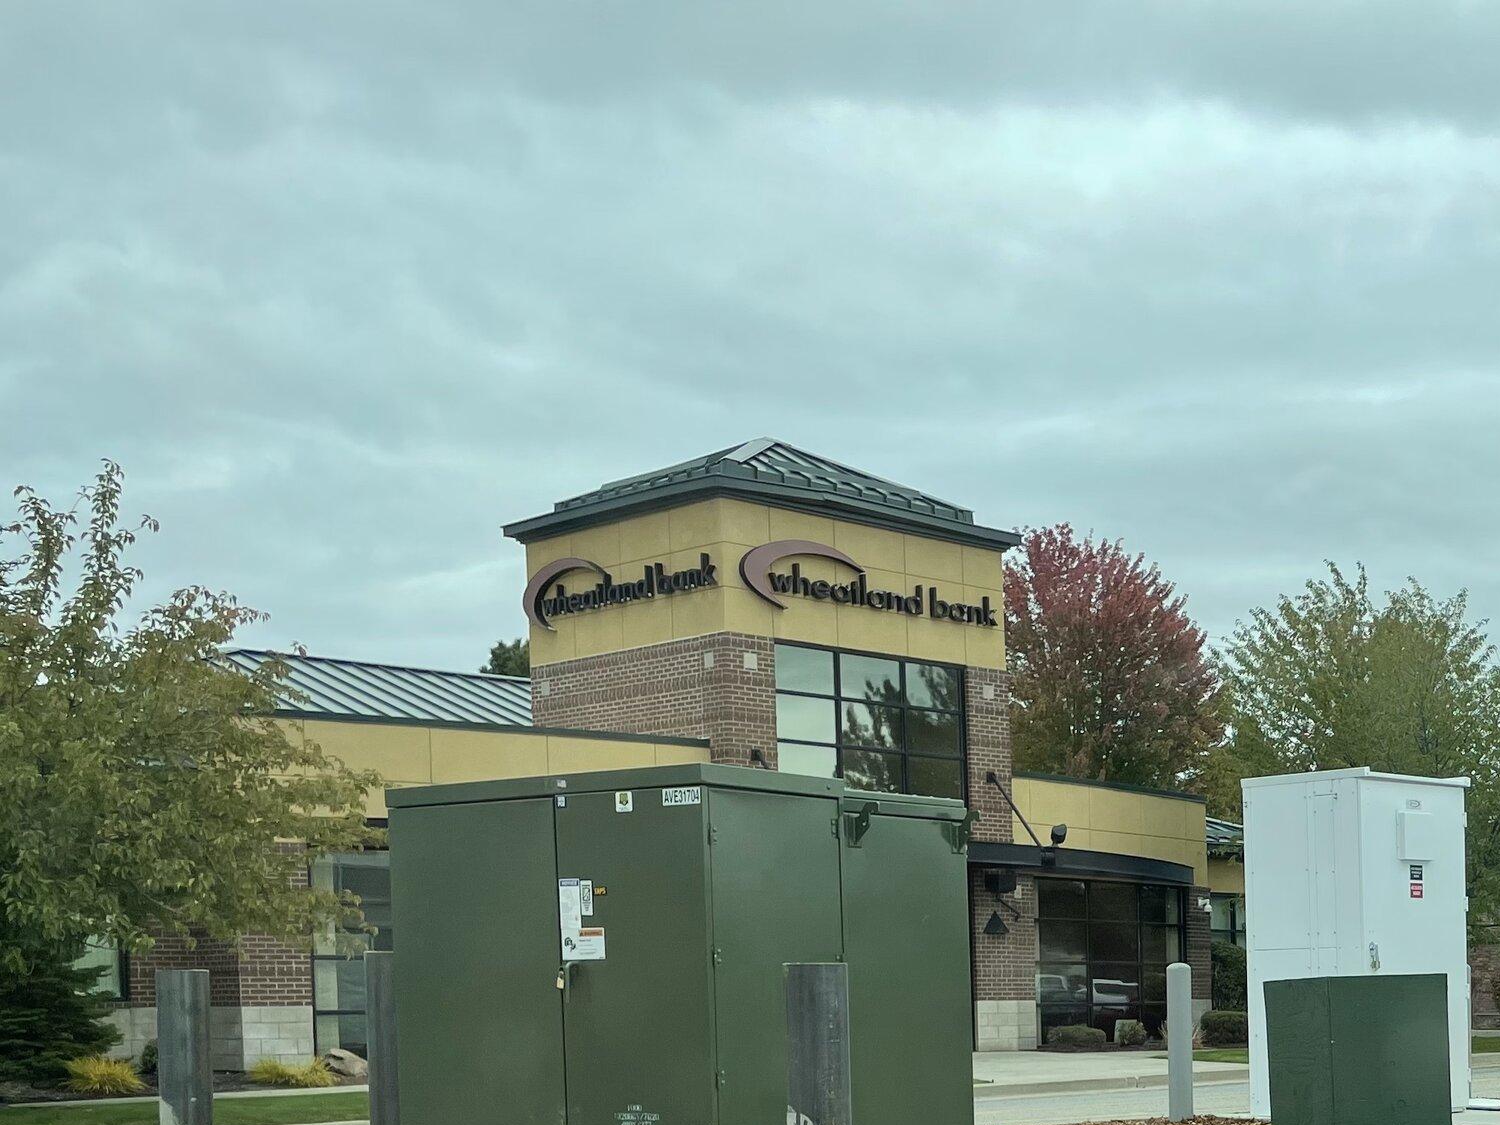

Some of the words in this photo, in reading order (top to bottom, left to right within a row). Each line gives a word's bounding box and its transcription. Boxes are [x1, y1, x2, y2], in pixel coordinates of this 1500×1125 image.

[541, 565, 655, 616] wheatland
[655, 552, 718, 595] bank
[768, 563, 924, 615] wheatland
[928, 587, 998, 627] bank
[664, 789, 700, 804] AVE31704
